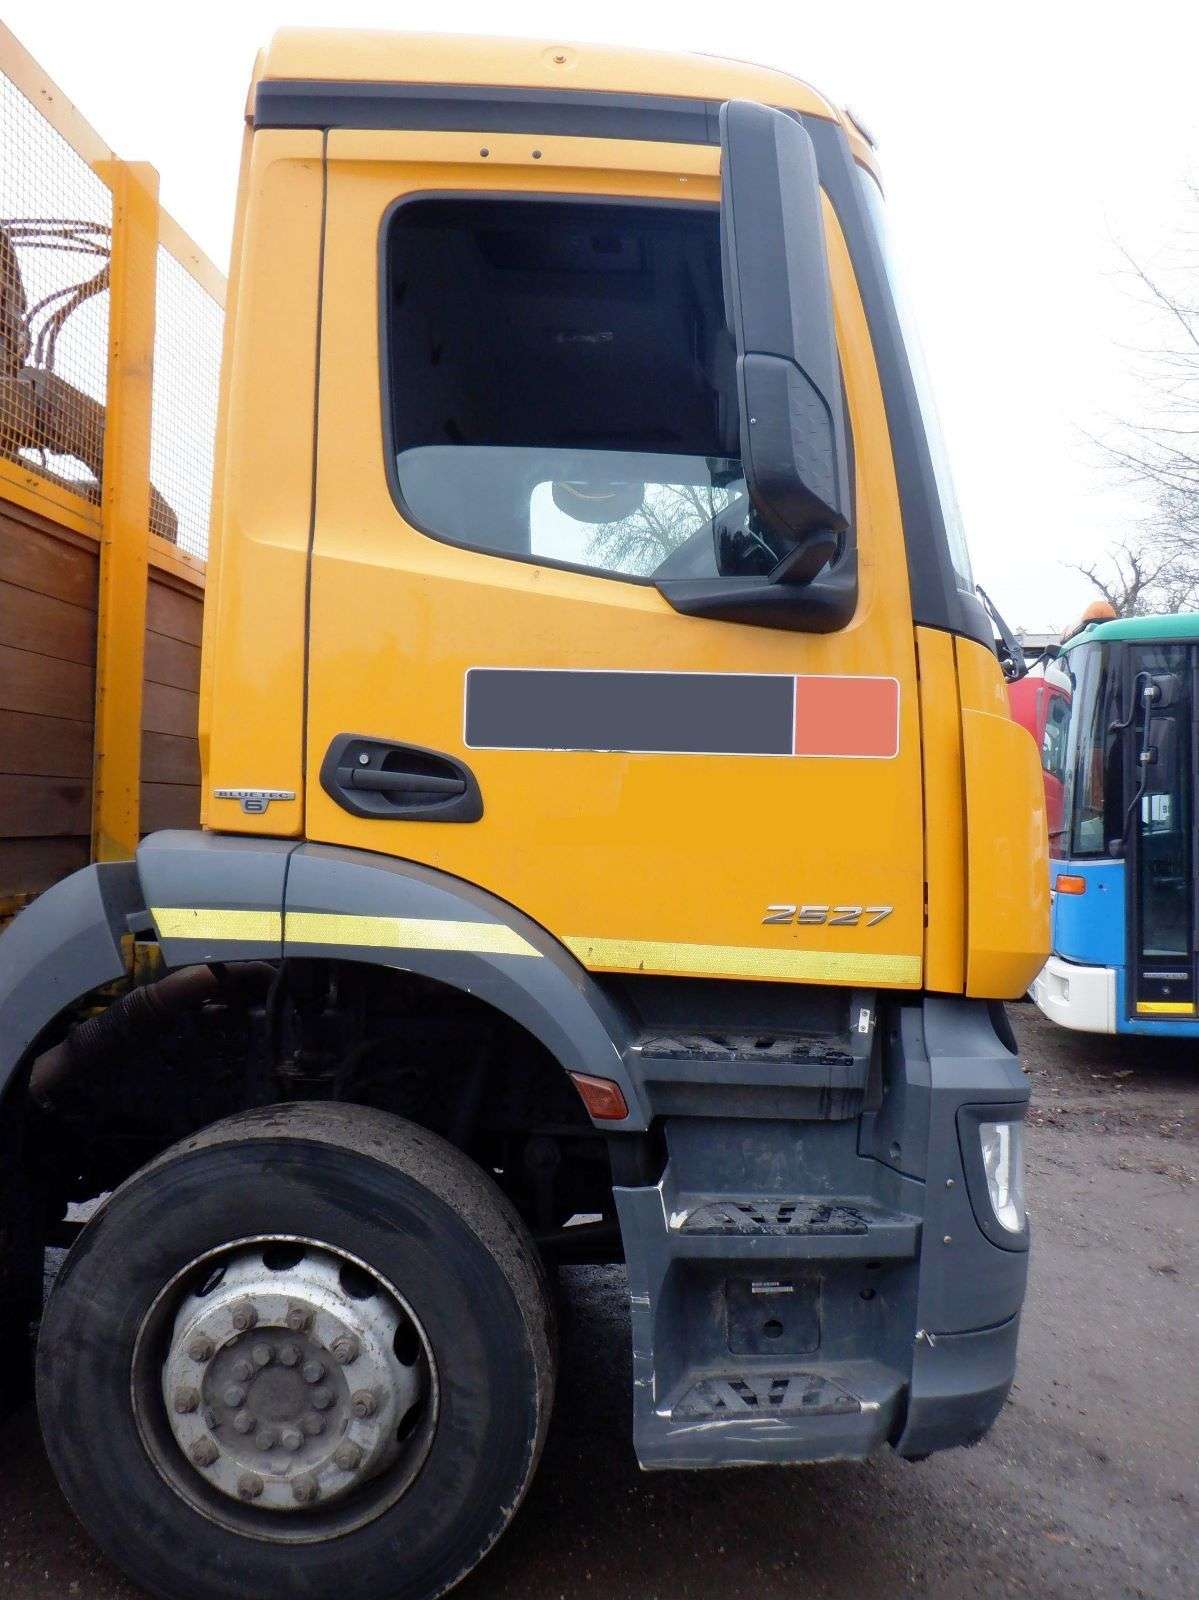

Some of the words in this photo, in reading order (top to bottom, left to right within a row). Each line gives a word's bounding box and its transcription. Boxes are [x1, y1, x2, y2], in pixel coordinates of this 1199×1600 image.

[218, 790, 289, 799] BLUETEC
[245, 799, 263, 811] 6
[762, 904, 894, 927] 2527
